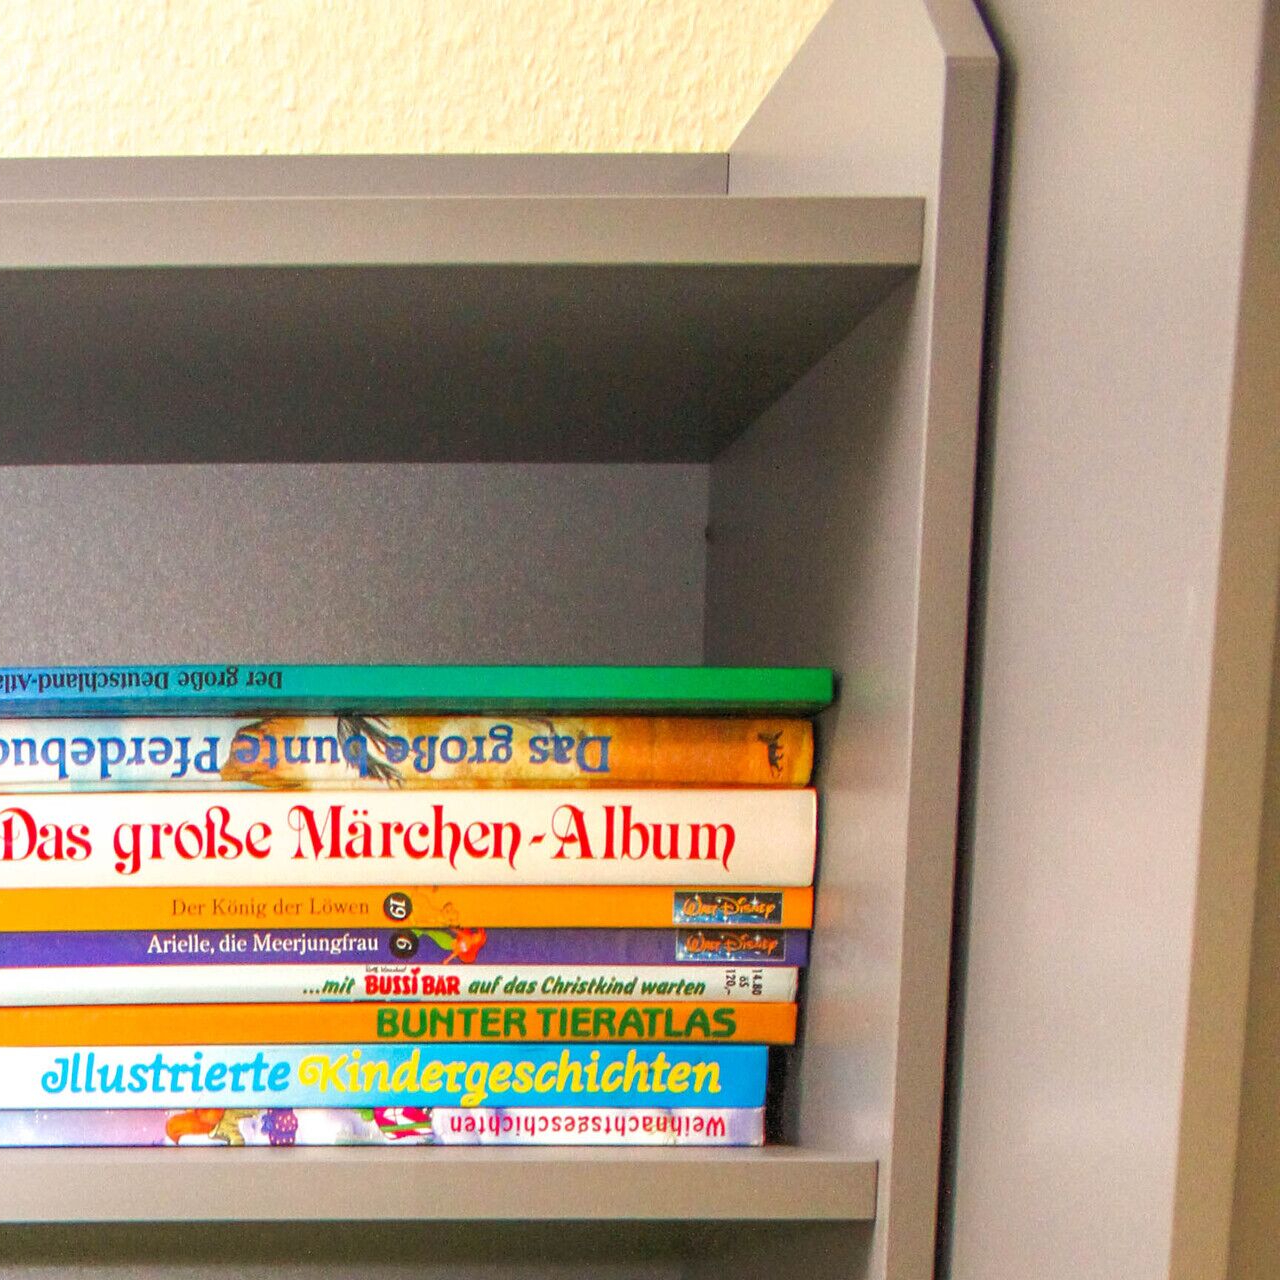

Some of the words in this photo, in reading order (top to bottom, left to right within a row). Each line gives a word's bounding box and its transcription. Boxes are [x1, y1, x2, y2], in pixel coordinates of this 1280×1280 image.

[178, 666, 239, 688] große
[246, 668, 283, 689] Der
[233, 733, 368, 777] bunte
[386, 725, 514, 773] große
[529, 734, 612, 773] Das
[113, 805, 272, 875] große
[288, 804, 736, 872] Märchen-Album
[172, 899, 204, 916] Der
[209, 898, 267, 919] König
[273, 898, 303, 915] der
[310, 898, 370, 915] Löwen
[147, 934, 215, 955] Arielle,
[219, 933, 247, 952] die
[253, 933, 379, 956] Meerjungfrau
[468, 977, 500, 996] auf
[504, 977, 538, 995] das
[541, 975, 635, 996] Christkind
[640, 979, 706, 996] warten
[377, 1007, 527, 1038] BUNTER
[537, 1007, 737, 1038] TIERATLAS
[41, 1051, 291, 1094] Illustrierte
[298, 1049, 722, 1107] Kindergeschichten
[450, 1115, 726, 1139] Weihnachtsgeschichten
